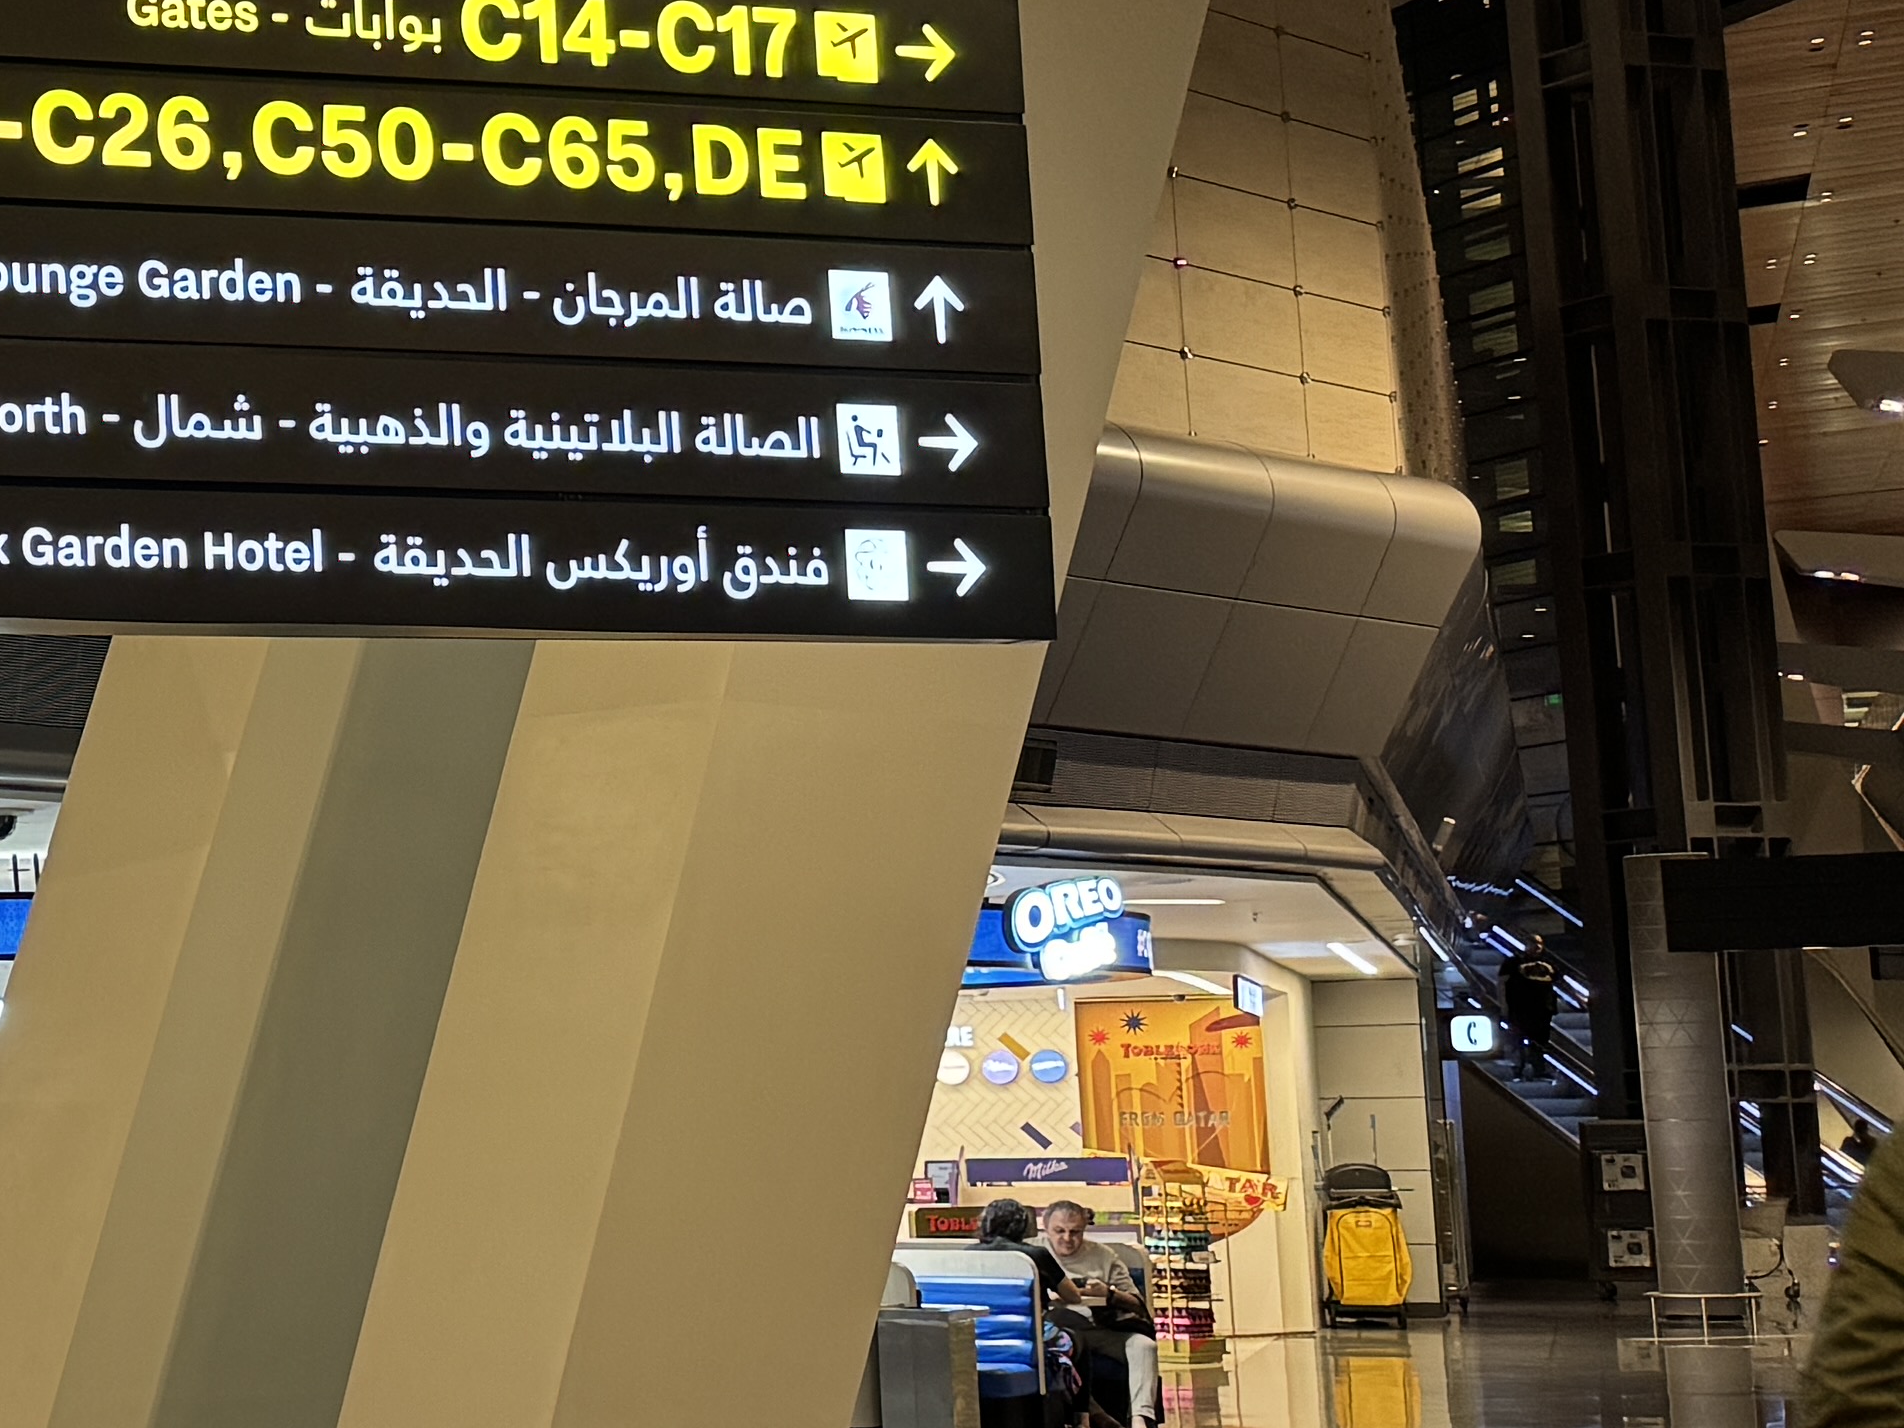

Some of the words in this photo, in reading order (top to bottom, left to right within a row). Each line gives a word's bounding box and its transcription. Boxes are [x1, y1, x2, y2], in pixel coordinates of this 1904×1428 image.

[136, 256, 303, 305] Garden
[349, 265, 509, 321] الحديقة
[551, 270, 702, 329] المرجان
[712, 277, 814, 326] صالة
[132, 392, 264, 450] شمال
[307, 401, 492, 460] والذهبية
[502, 407, 683, 465] البلاتينية
[693, 411, 822, 460] الصالة
[20, 522, 190, 571] Garden
[202, 527, 325, 574] Hotel
[372, 531, 533, 588] الحديقة
[544, 524, 710, 594] أوريكس
[721, 543, 831, 601] فندق
[1013, 877, 1123, 945] OREO
[1022, 1160, 1069, 1180] Milka
